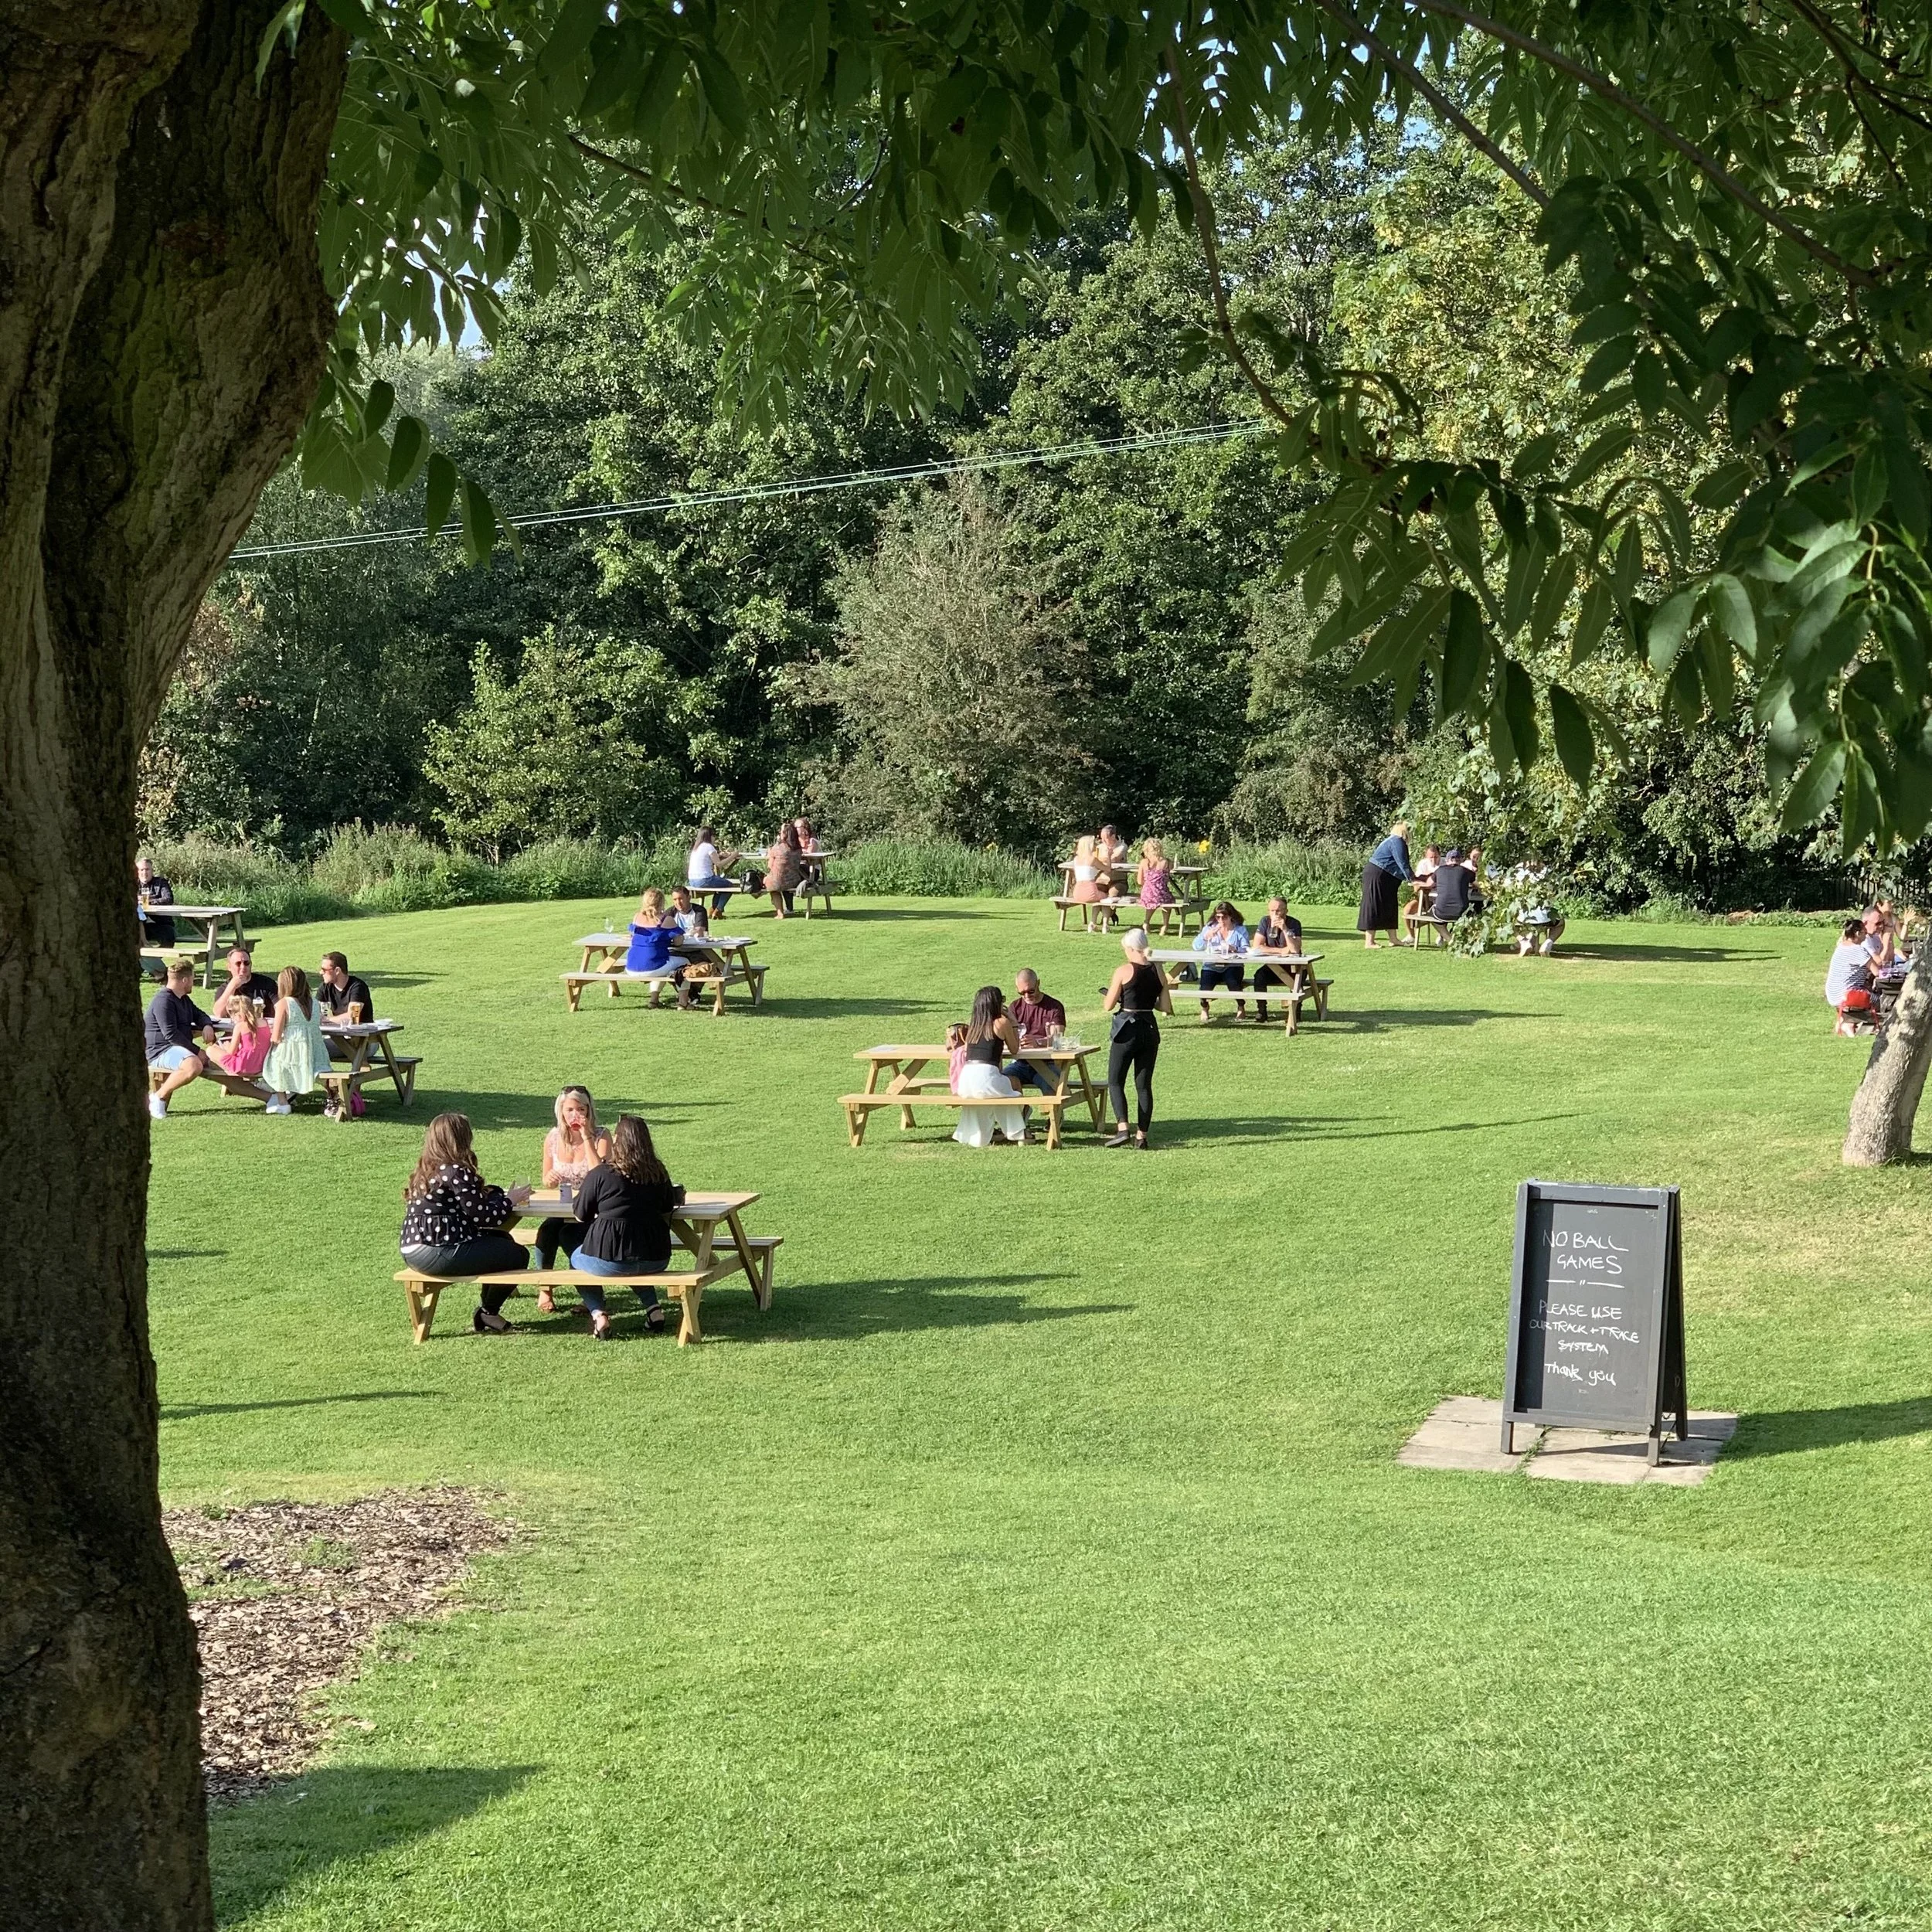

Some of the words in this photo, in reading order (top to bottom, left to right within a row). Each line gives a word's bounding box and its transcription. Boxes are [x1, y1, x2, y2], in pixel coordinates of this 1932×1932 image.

[1543, 1229, 1568, 1248] NO
[1573, 1232, 1629, 1252] BALL
[1557, 1254, 1622, 1274] GAMES
[1539, 1299, 1587, 1318] PLEASE
[1591, 1305, 1623, 1320] USE
[1557, 1339, 1609, 1355] SYSTEM
[1544, 1361, 1583, 1382] Thank
[1587, 1370, 1617, 1386] you
